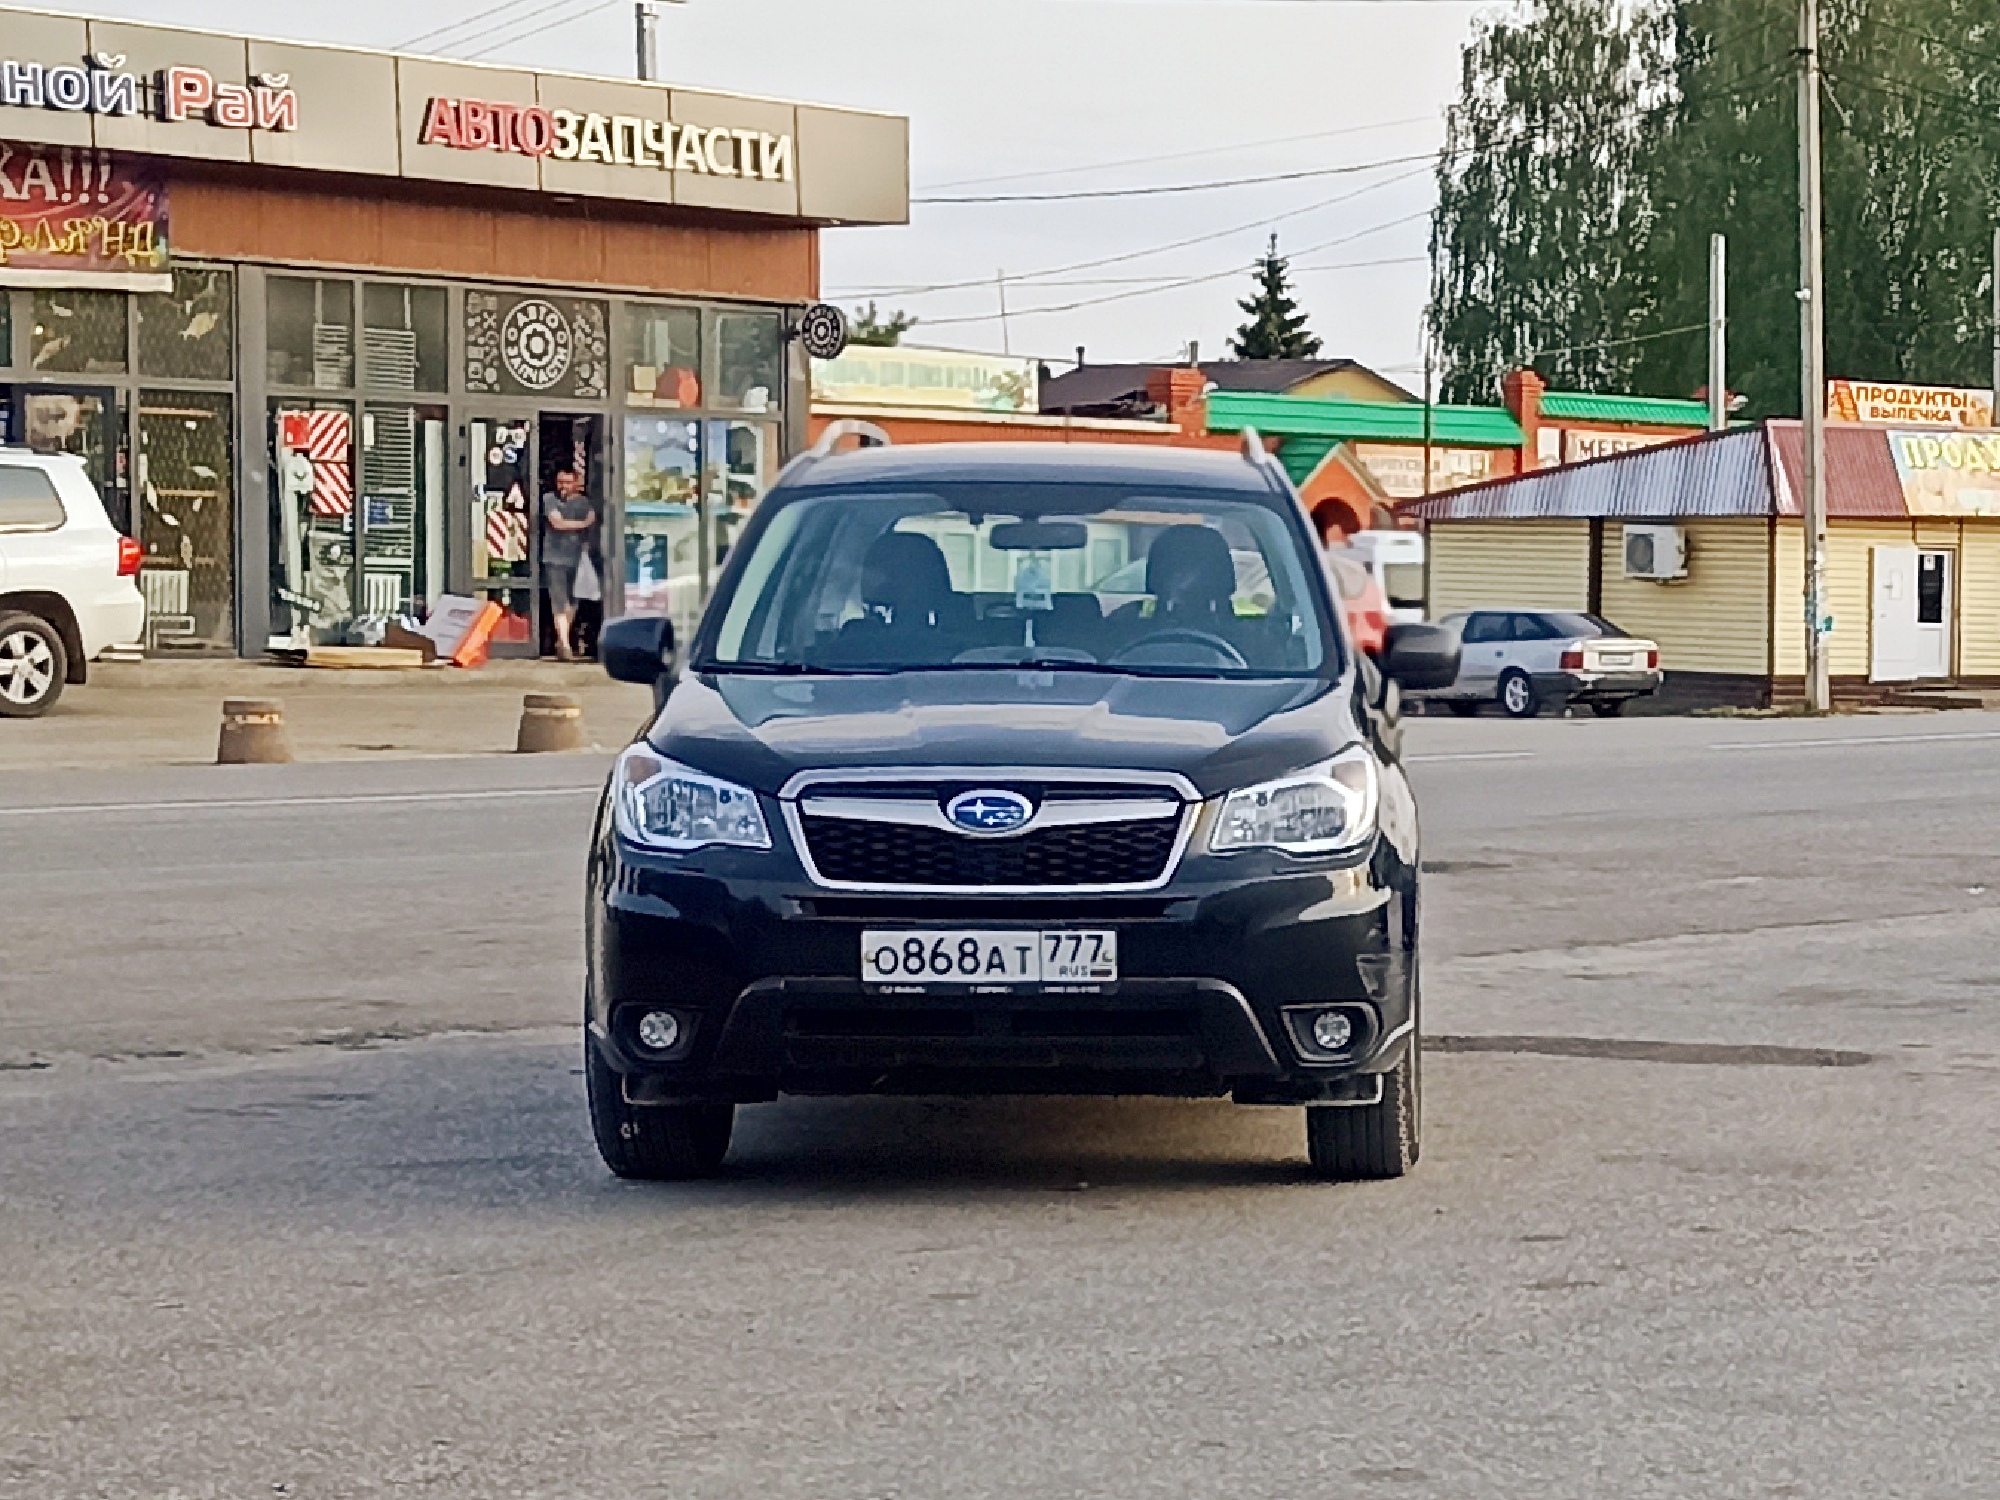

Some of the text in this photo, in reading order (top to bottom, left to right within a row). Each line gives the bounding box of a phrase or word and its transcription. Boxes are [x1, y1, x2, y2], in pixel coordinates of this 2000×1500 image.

[166, 66, 298, 131] Рай
[420, 97, 793, 181] АВТОЗАПЧАСТИ
[1856, 386, 1968, 408] ПРОДУКТЫ
[1870, 406, 1952, 422] ВЫПЕЧКА
[1044, 934, 1103, 963] 777
[1059, 965, 1088, 976] RUS
